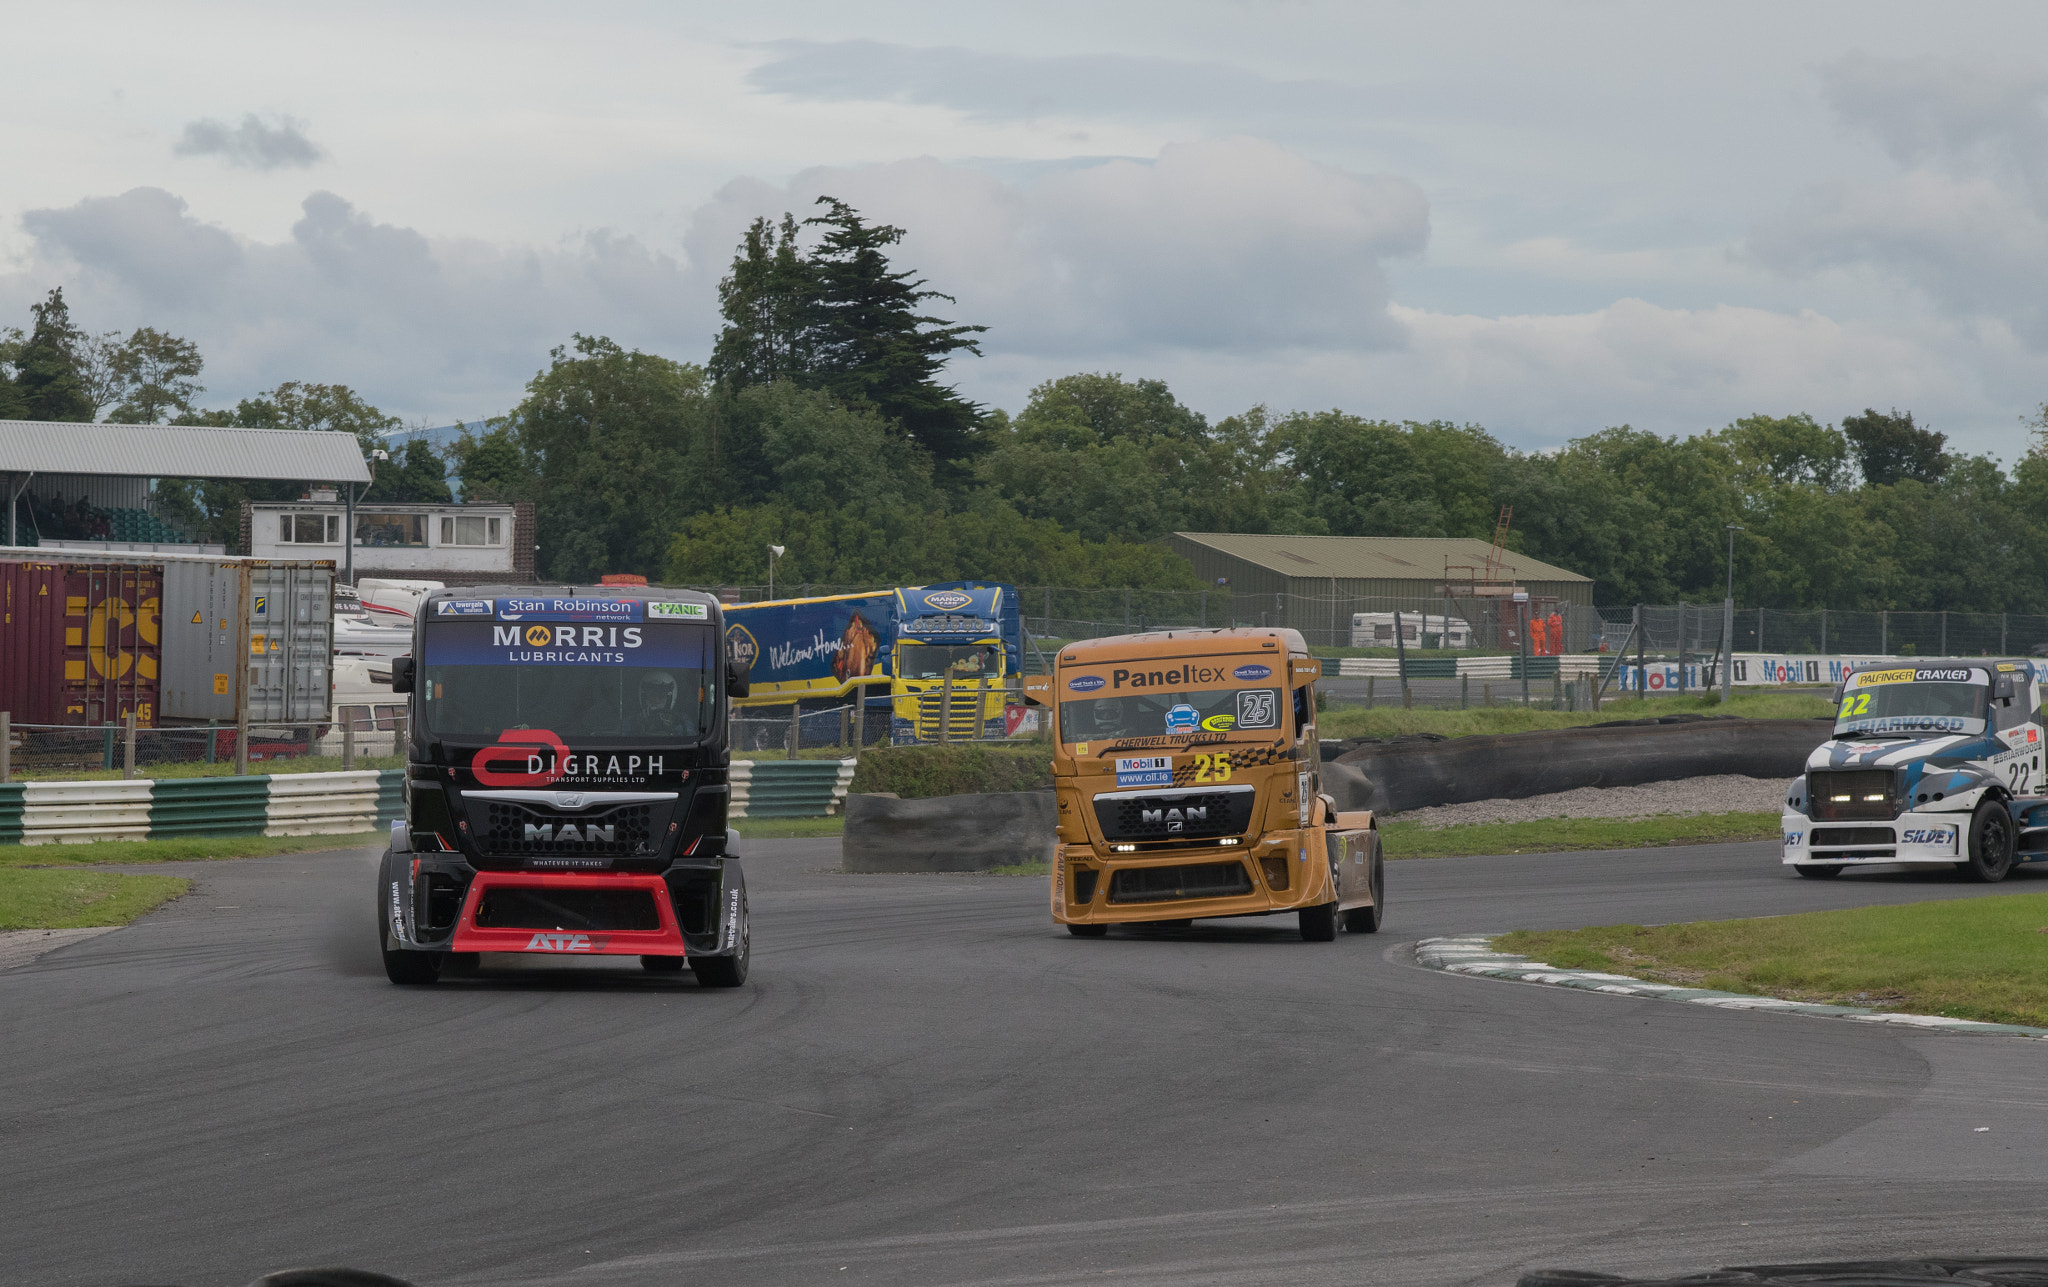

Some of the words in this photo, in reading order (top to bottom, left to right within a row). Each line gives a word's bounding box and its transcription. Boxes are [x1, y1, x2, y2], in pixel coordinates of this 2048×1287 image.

[508, 599, 545, 611] Stan
[554, 599, 631, 613] Robinson
[492, 625, 643, 649] MORRIS
[509, 651, 625, 663] LUBRICANTS
[769, 641, 814, 670] Welcome
[1112, 664, 1226, 689] Paneltex
[1763, 660, 1804, 682] Mobil
[1805, 660, 1820, 682] 1
[1859, 671, 1913, 685] PALFINGER
[1915, 669, 1968, 681] CRAYLER
[1240, 694, 1274, 725] 25
[1839, 693, 1871, 719] 22
[1847, 716, 1965, 733] BRIARWOOD
[1114, 736, 1167, 748] CHERWELL
[1169, 733, 1206, 745] TRUCKS
[1207, 732, 1228, 743] LTD
[527, 754, 664, 775] DIGRAPH
[1122, 758, 1153, 770] Mobil
[1154, 758, 1165, 768] 1
[1194, 753, 1232, 783] 25
[1119, 772, 1169, 783] www.oil.ie
[2008, 762, 2030, 795] 22
[1142, 806, 1207, 823] MAN
[524, 823, 615, 842] MAN
[1901, 829, 1955, 844] SILVEY
